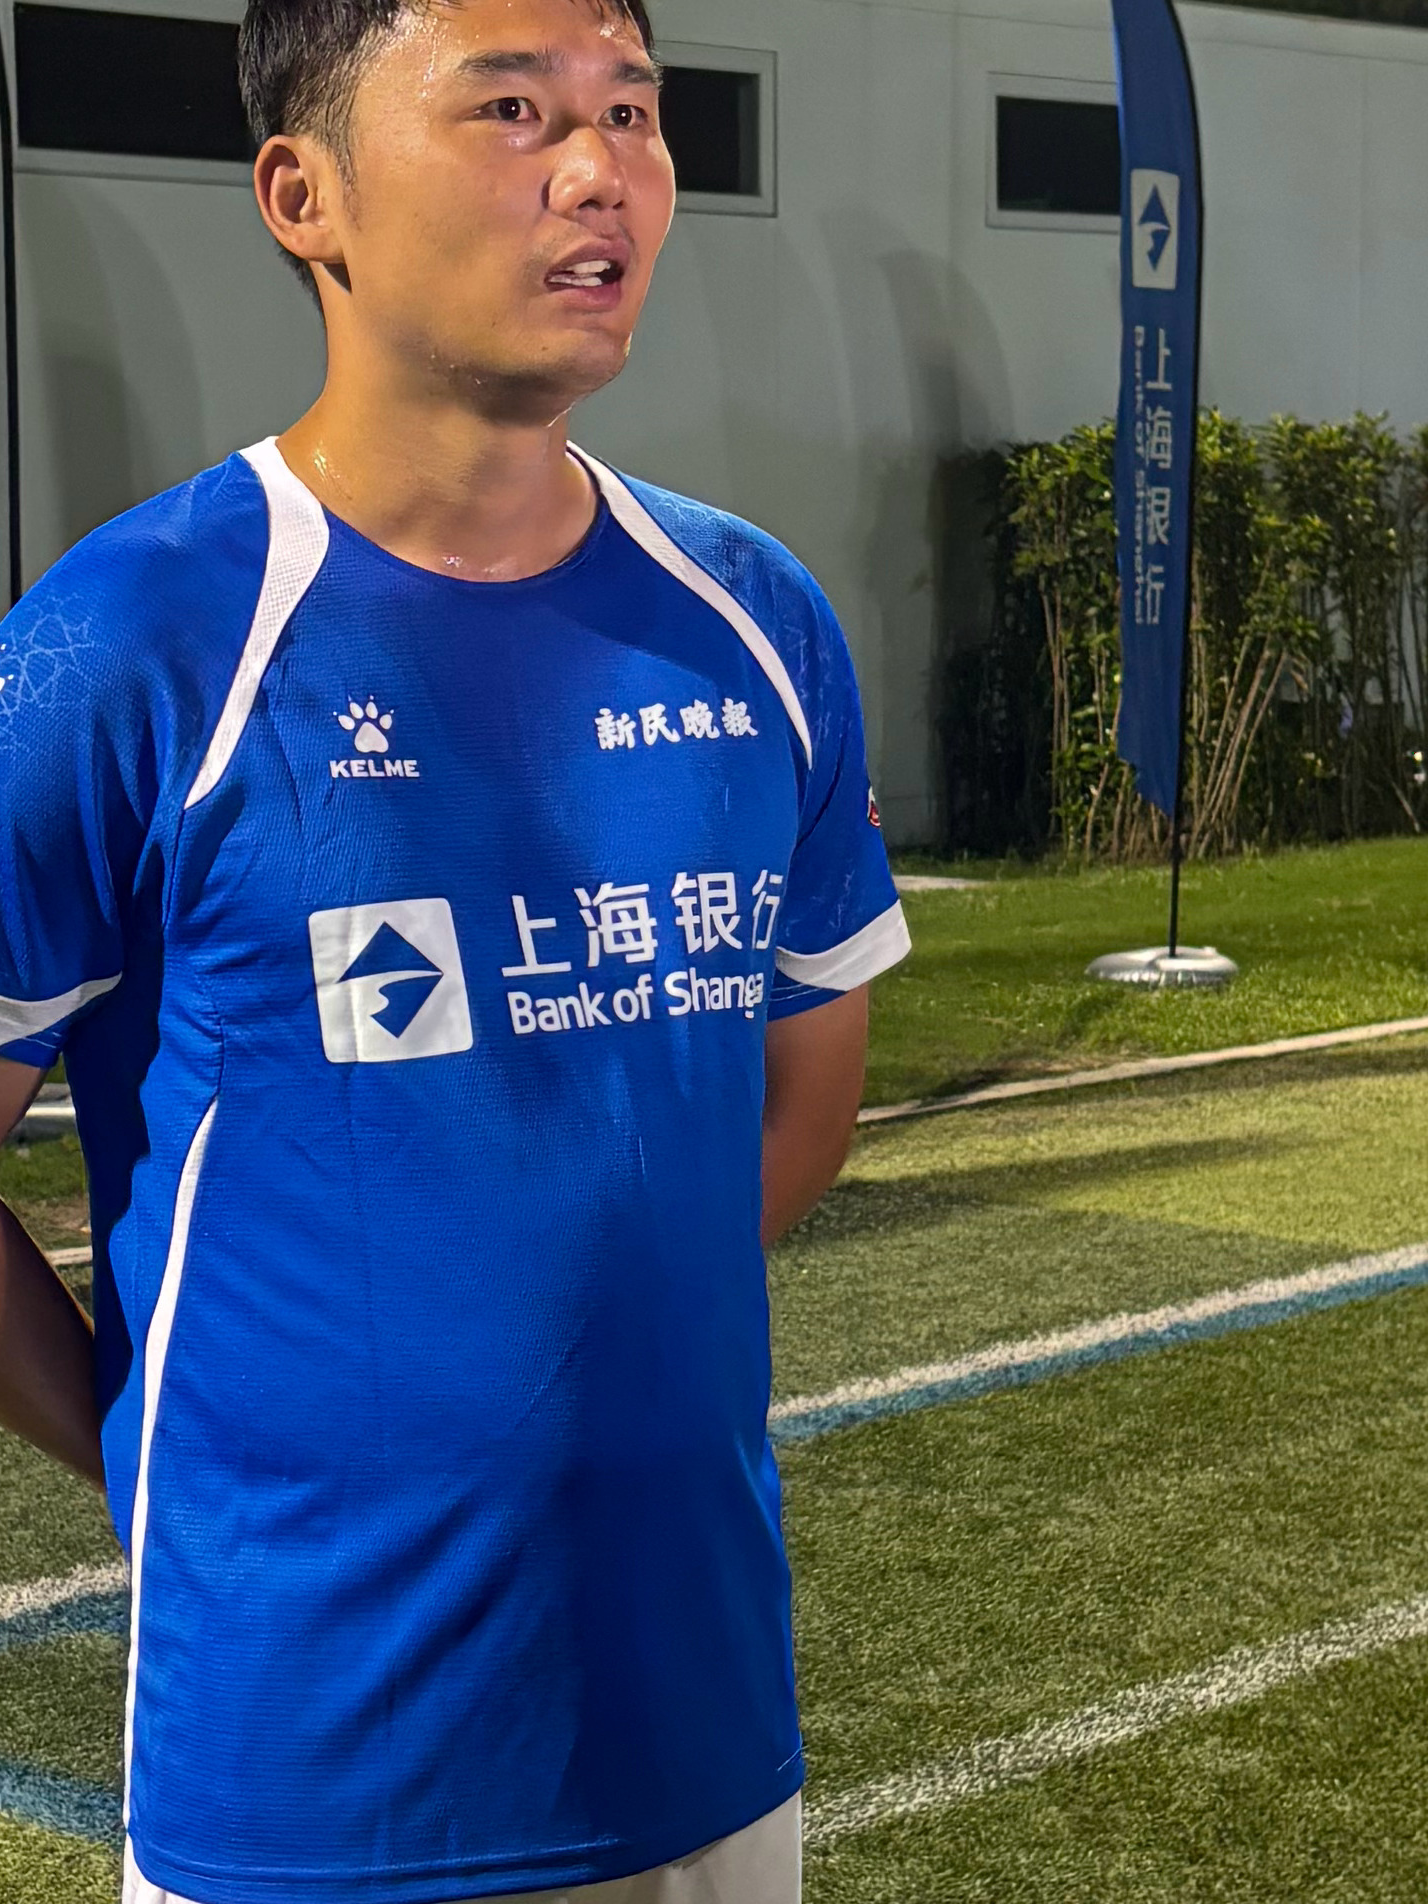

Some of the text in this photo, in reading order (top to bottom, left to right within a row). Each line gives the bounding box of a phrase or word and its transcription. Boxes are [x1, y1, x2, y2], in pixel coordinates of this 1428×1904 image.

[329, 758, 421, 779] KELME
[501, 869, 784, 978] 上海银行
[507, 981, 611, 1036] Bank
[612, 972, 655, 1024] of
